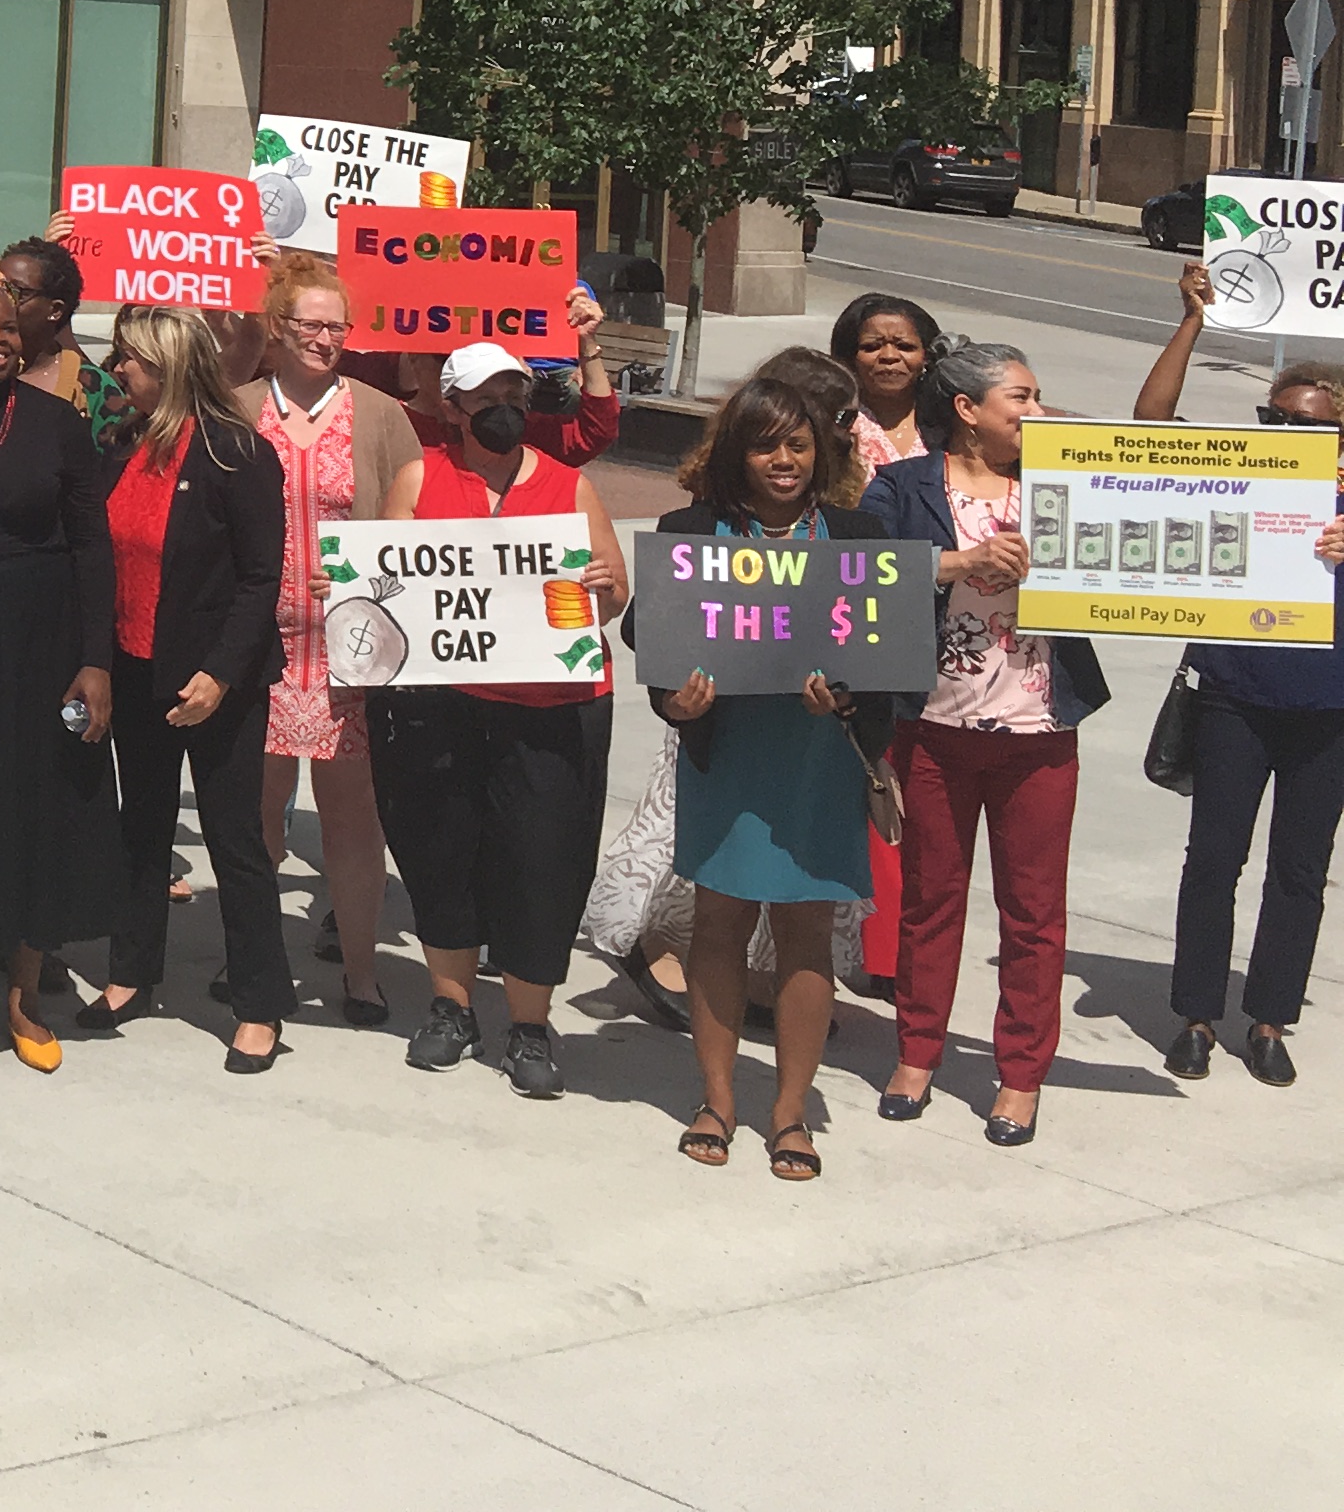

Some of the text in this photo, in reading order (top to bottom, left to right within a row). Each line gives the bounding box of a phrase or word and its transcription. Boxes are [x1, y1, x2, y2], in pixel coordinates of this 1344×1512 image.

[299, 123, 431, 170] CLOSE THE
[333, 161, 382, 193] PAY
[69, 182, 201, 220] BLACK
[1259, 196, 1344, 233] CLOS
[67, 226, 261, 270] are WORTH
[354, 226, 565, 267] ECONOMIC
[114, 268, 233, 308] MORE!
[370, 303, 549, 338] JUSTICE
[1061, 447, 1300, 470] Fights for Economic Justice
[1113, 435, 1248, 453] Rochester NOW
[1090, 474, 1251, 496] #EqualPayNOW
[377, 541, 558, 578] CLOSE THE
[670, 542, 899, 587] SHOW US
[434, 586, 492, 622] PAY
[700, 601, 791, 642] THE
[1090, 604, 1206, 628] Equal Pay Day
[430, 627, 497, 663] GAP
